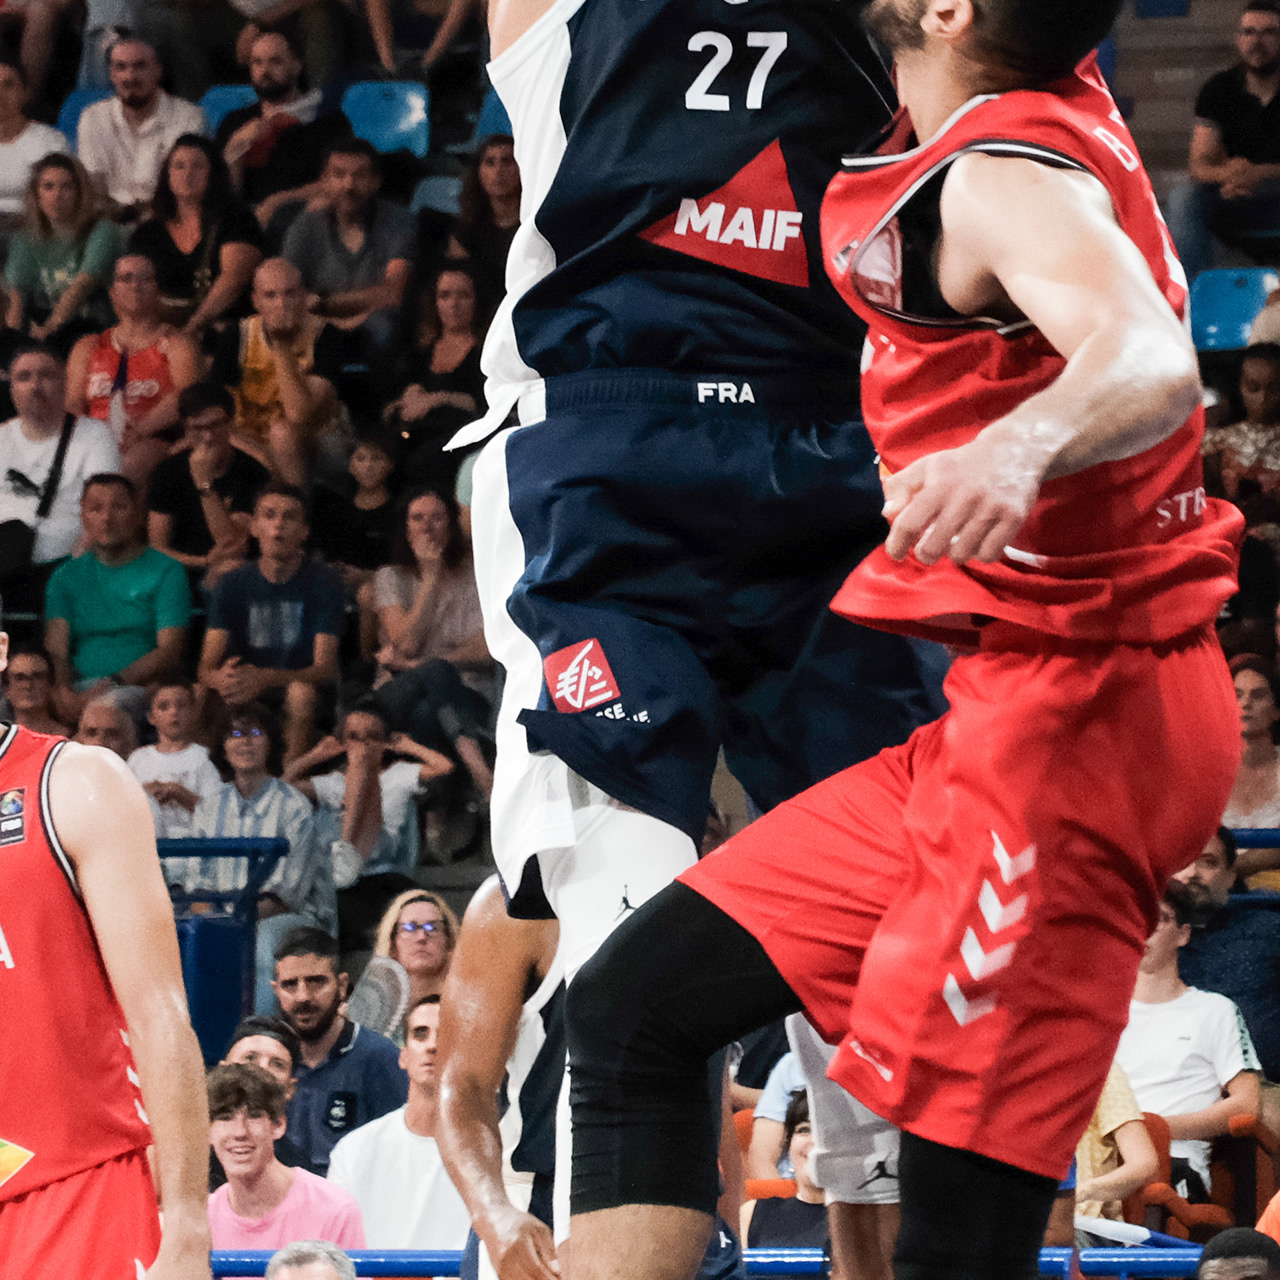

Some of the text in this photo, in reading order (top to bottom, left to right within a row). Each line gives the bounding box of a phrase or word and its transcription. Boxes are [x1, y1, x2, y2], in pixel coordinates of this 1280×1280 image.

[685, 31, 788, 111] 27
[674, 197, 803, 251] MAIF
[697, 382, 756, 404] FRA
